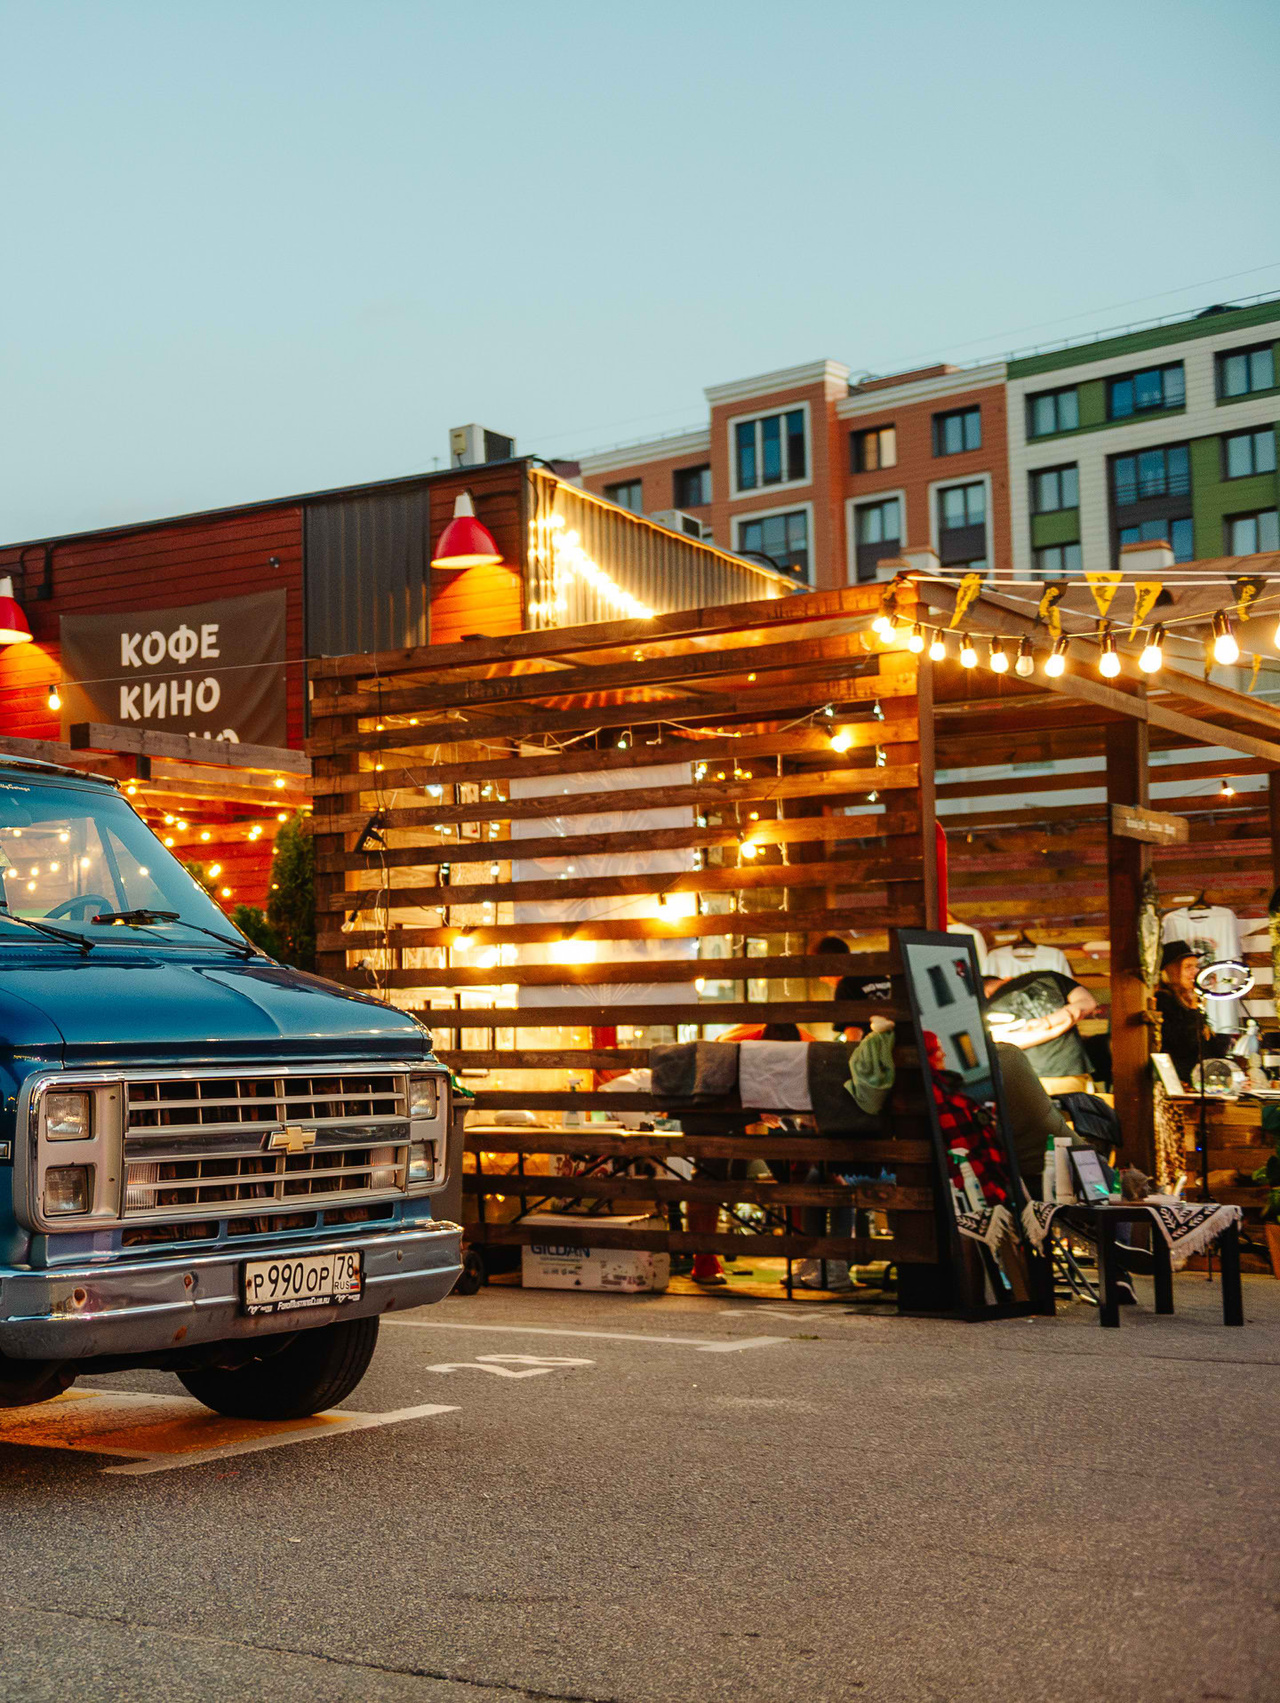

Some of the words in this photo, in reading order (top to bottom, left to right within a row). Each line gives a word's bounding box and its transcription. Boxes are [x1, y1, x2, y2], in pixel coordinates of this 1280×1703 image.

[120, 623, 220, 668] КОФЕ
[119, 676, 221, 721] КИНО
[337, 1255, 354, 1280] 78
[334, 1281, 350, 1290] RUS
